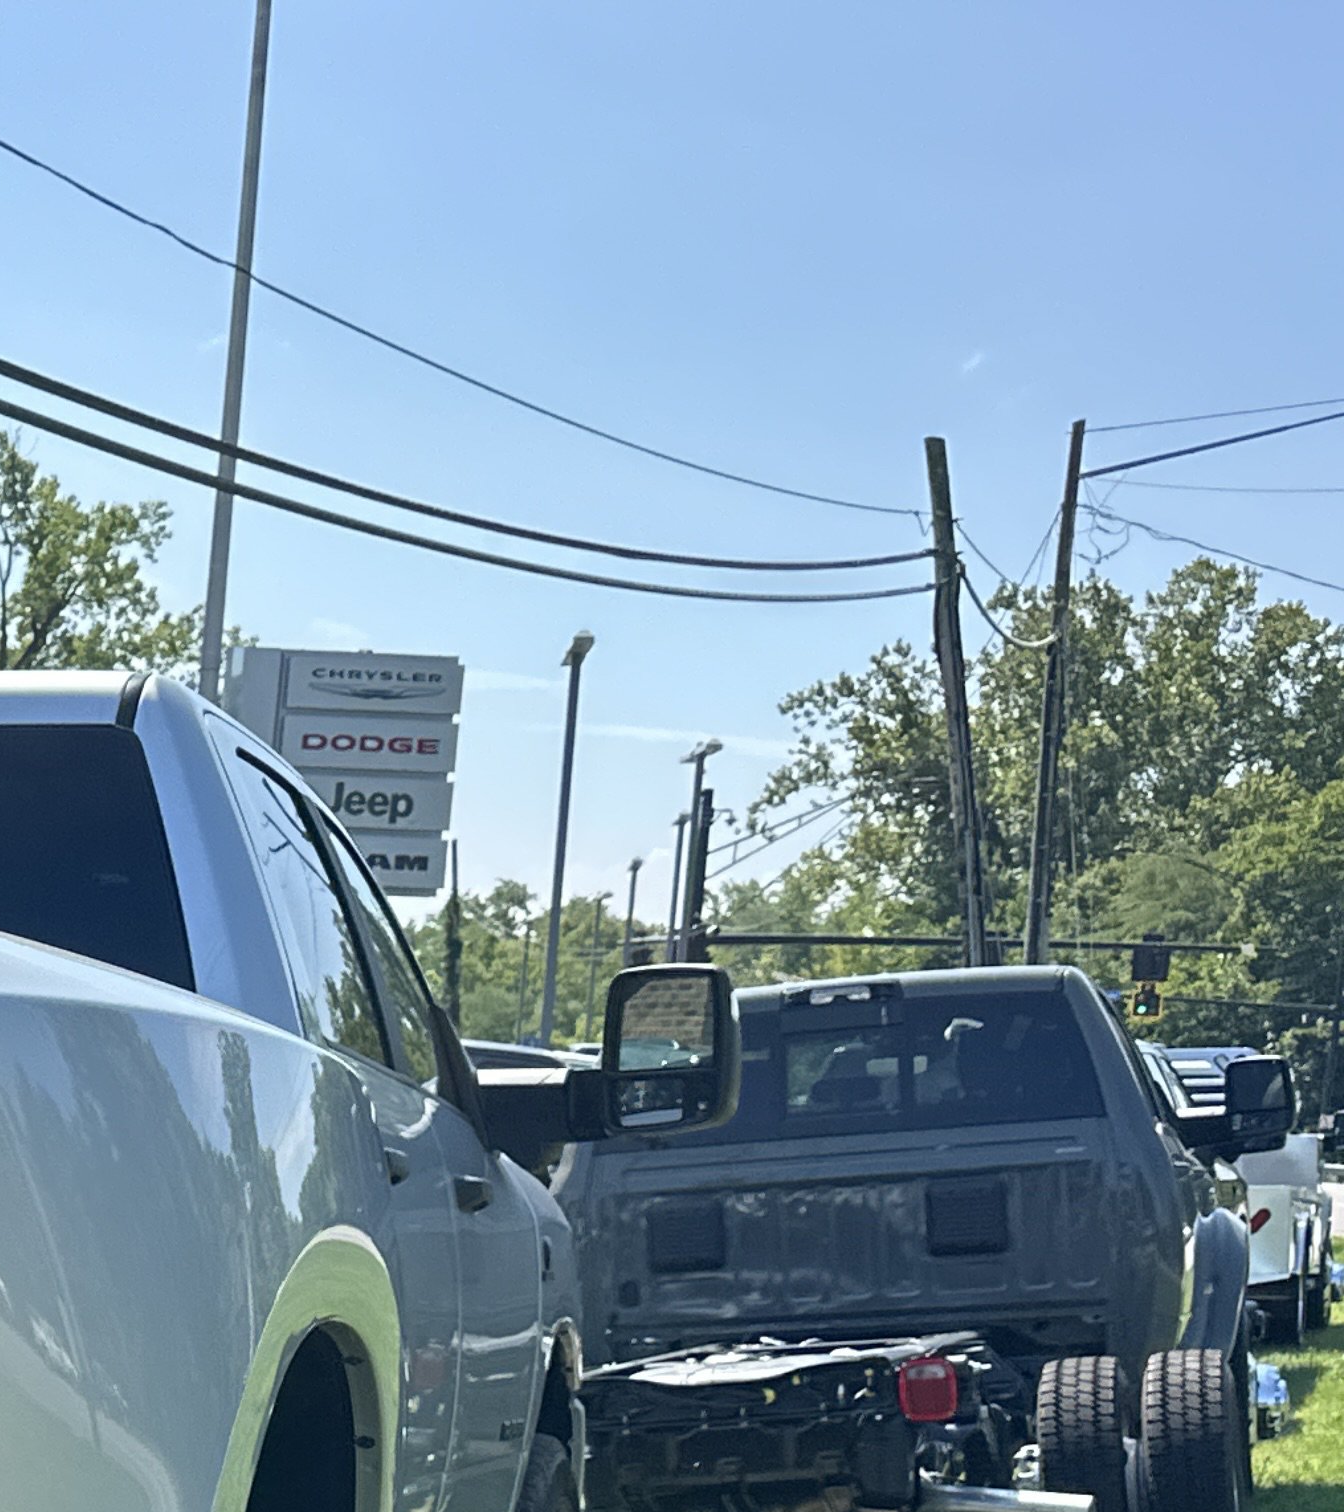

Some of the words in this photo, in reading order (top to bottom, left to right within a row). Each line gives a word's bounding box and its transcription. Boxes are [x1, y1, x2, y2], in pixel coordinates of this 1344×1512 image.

[311, 667, 444, 683] CHRYSLER
[301, 733, 441, 755] DODGE
[330, 782, 414, 824] Jeep
[366, 854, 429, 871] AM
